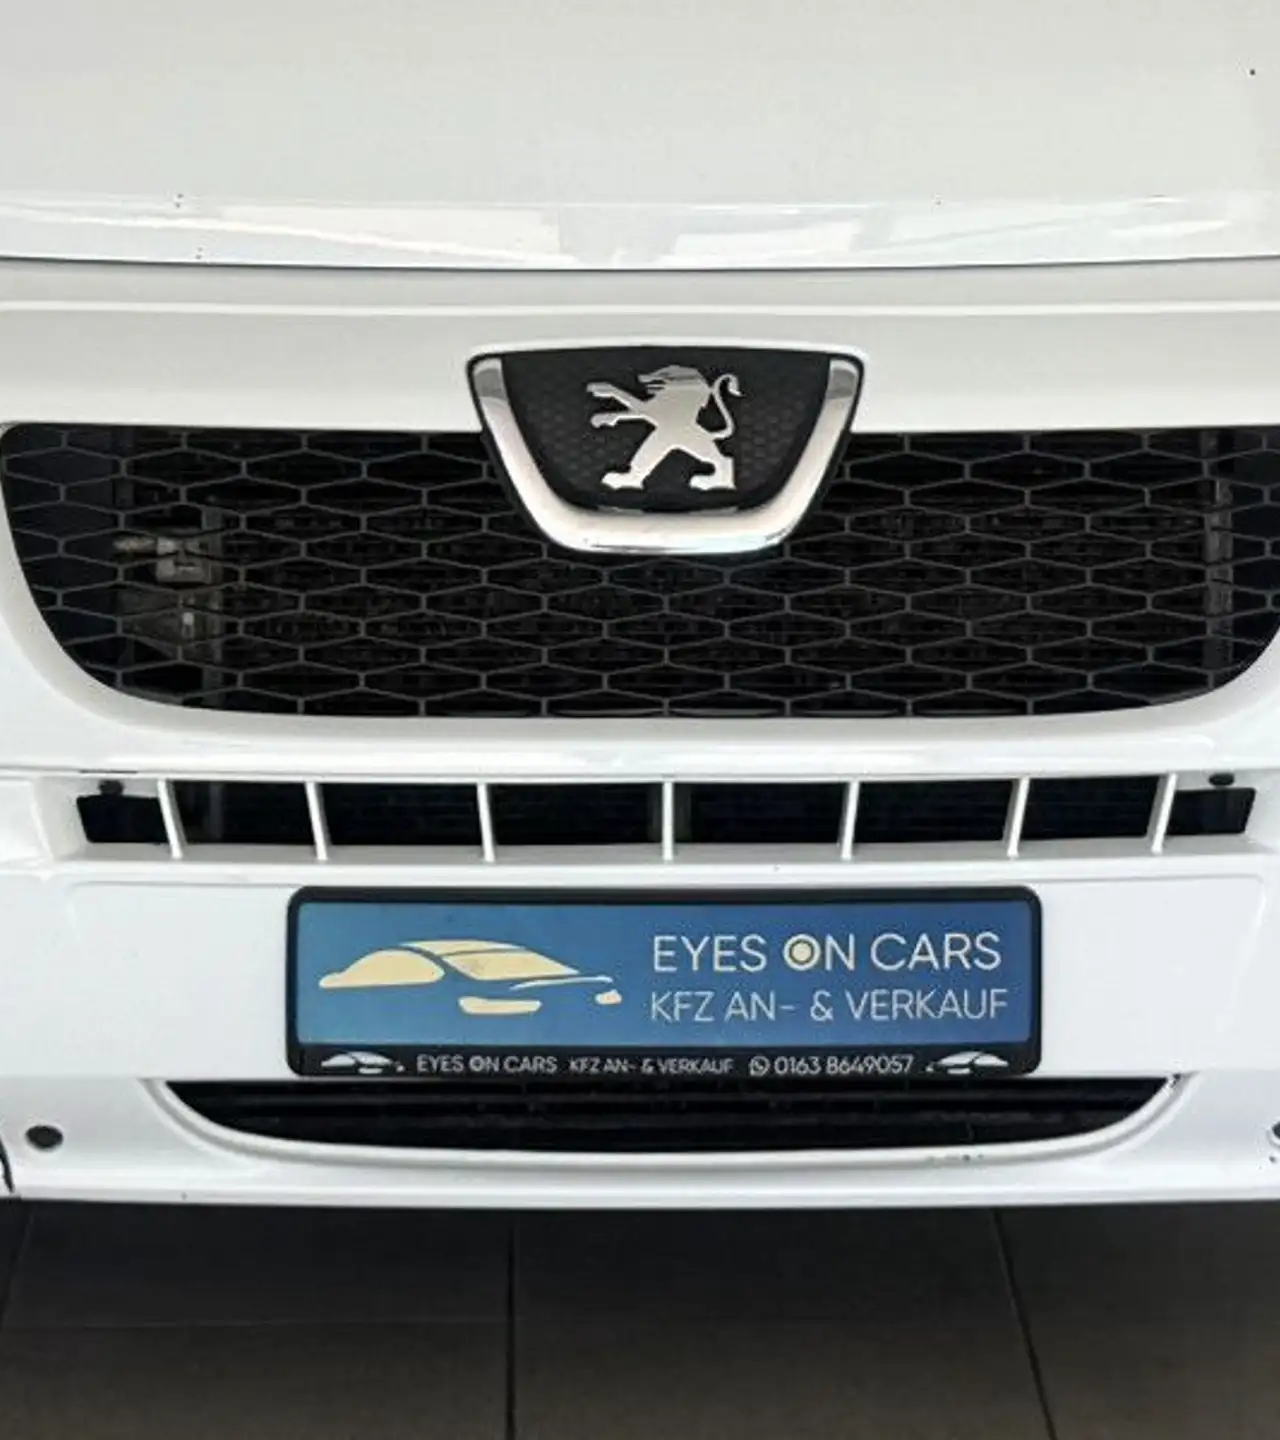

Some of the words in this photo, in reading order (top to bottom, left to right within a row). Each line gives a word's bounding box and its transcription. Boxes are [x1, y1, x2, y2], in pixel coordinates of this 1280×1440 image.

[653, 934, 767, 972] EYES
[782, 933, 856, 972] ON
[870, 931, 1002, 972] CARS
[650, 990, 715, 1022] KFZ
[724, 990, 797, 1021] AN-
[809, 990, 834, 1021] &
[845, 988, 1008, 1020] VERKAUF
[416, 1054, 464, 1073] EYES
[469, 1055, 501, 1073] ON
[503, 1054, 558, 1073] CARS
[570, 1057, 600, 1074] KFZ
[657, 1057, 734, 1074] VERKAUF
[773, 1055, 821, 1075] 0163
[826, 1054, 915, 1075] 8649057
